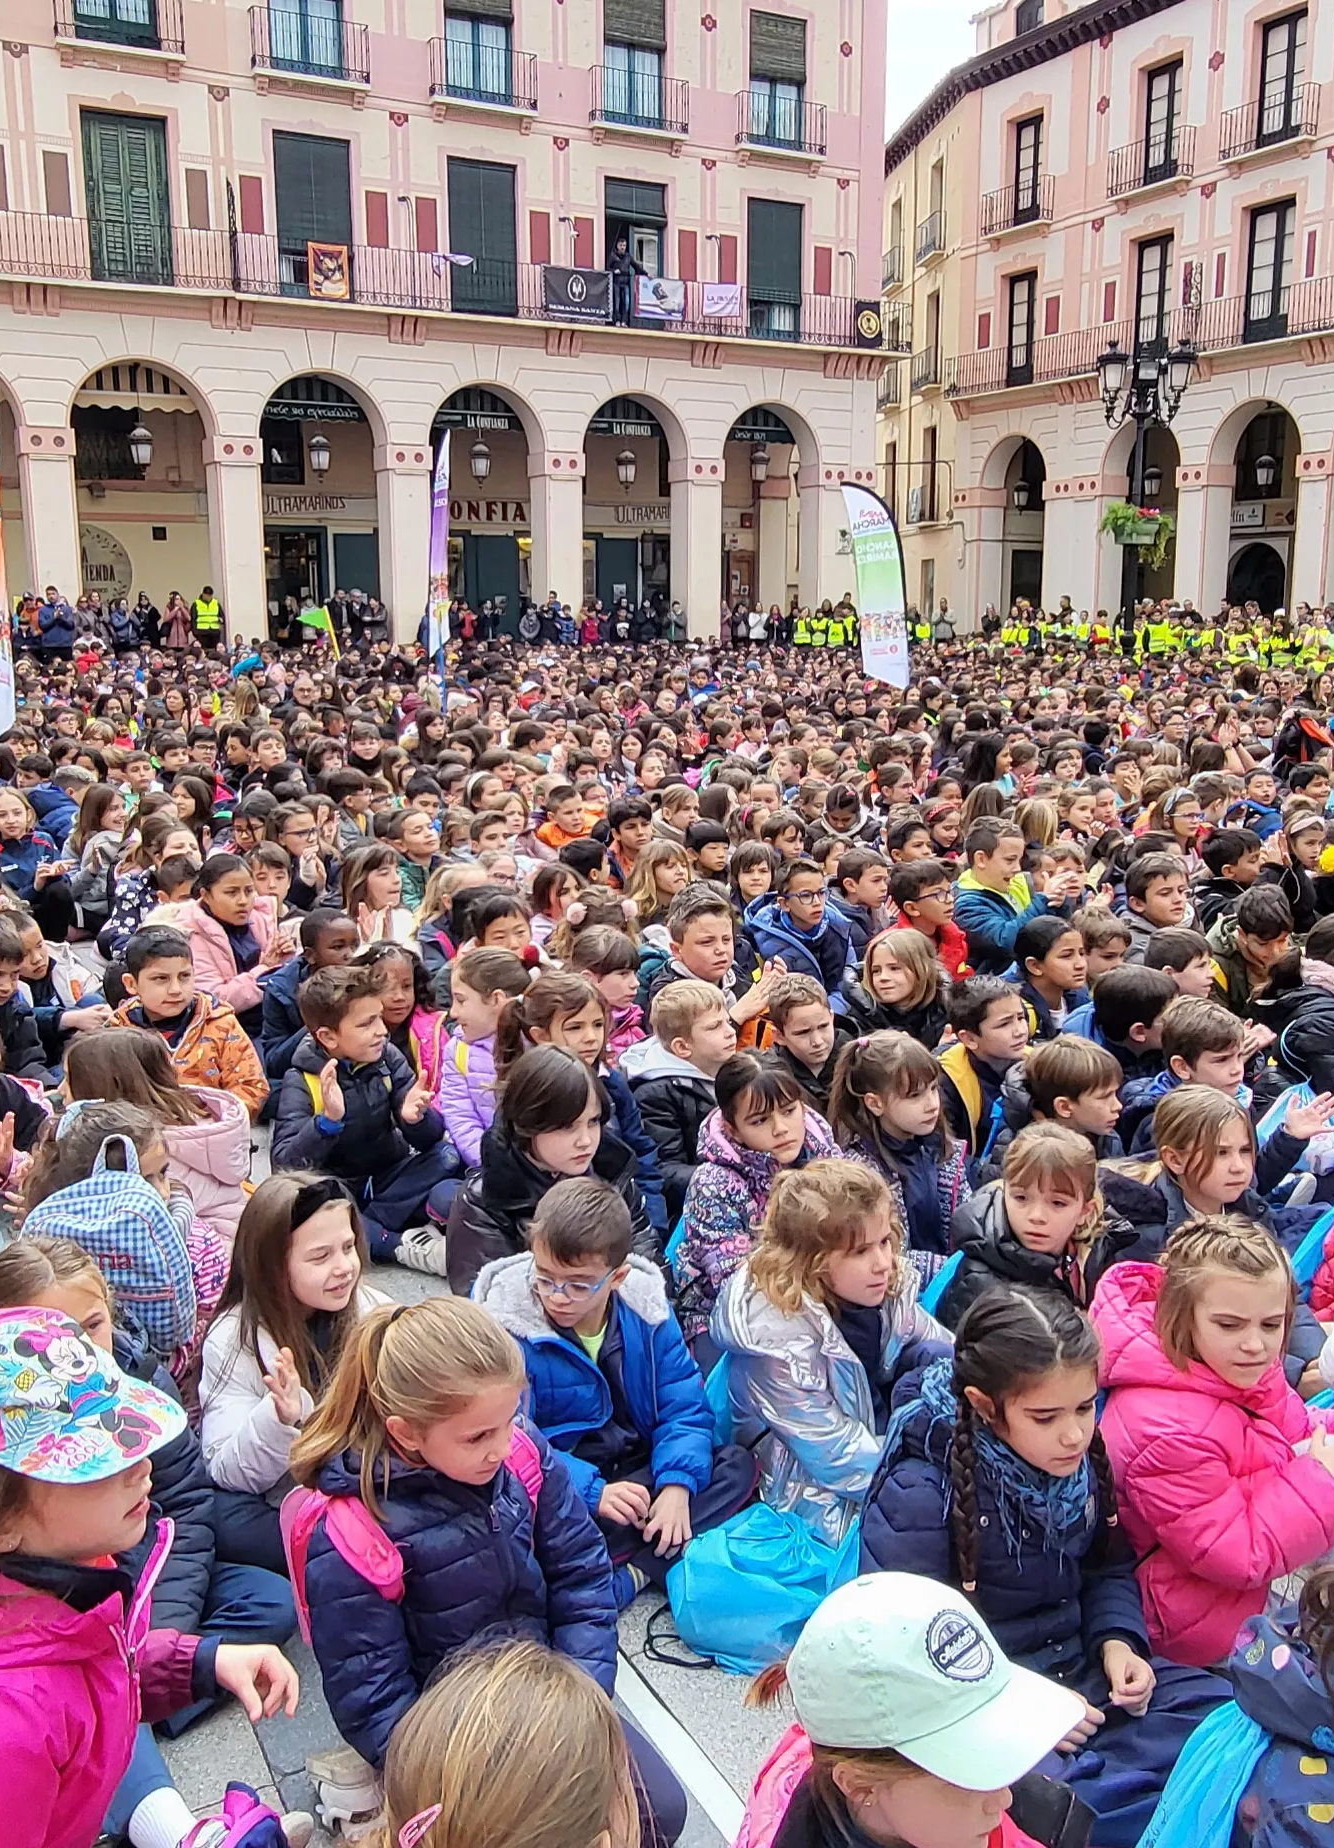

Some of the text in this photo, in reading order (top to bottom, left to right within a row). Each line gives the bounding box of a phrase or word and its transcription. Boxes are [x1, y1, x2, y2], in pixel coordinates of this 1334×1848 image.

[467, 414, 475, 428] LA
[476, 414, 509, 430] CONFIANZA
[612, 422, 652, 437] LA CONFIANZA
[83, 564, 116, 582] IENDA
